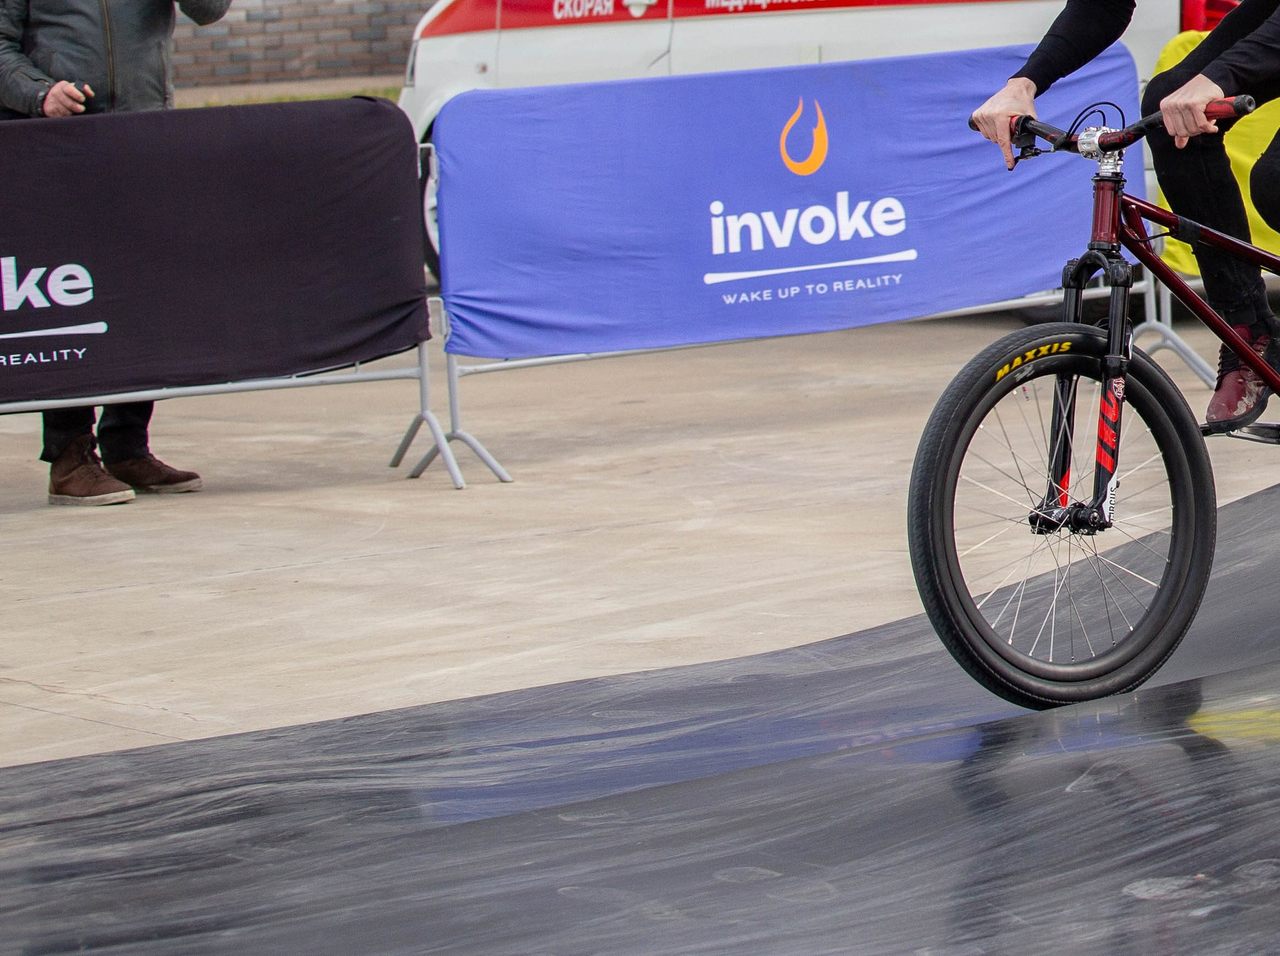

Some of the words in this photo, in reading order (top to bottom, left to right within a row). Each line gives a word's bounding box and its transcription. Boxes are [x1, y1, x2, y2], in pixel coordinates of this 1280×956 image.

[710, 191, 906, 255] invoke
[722, 289, 773, 305] WAKE
[777, 286, 800, 299] UP
[806, 283, 828, 295] TO
[833, 274, 903, 292] REALITY
[996, 341, 1072, 381] MAXXIS
